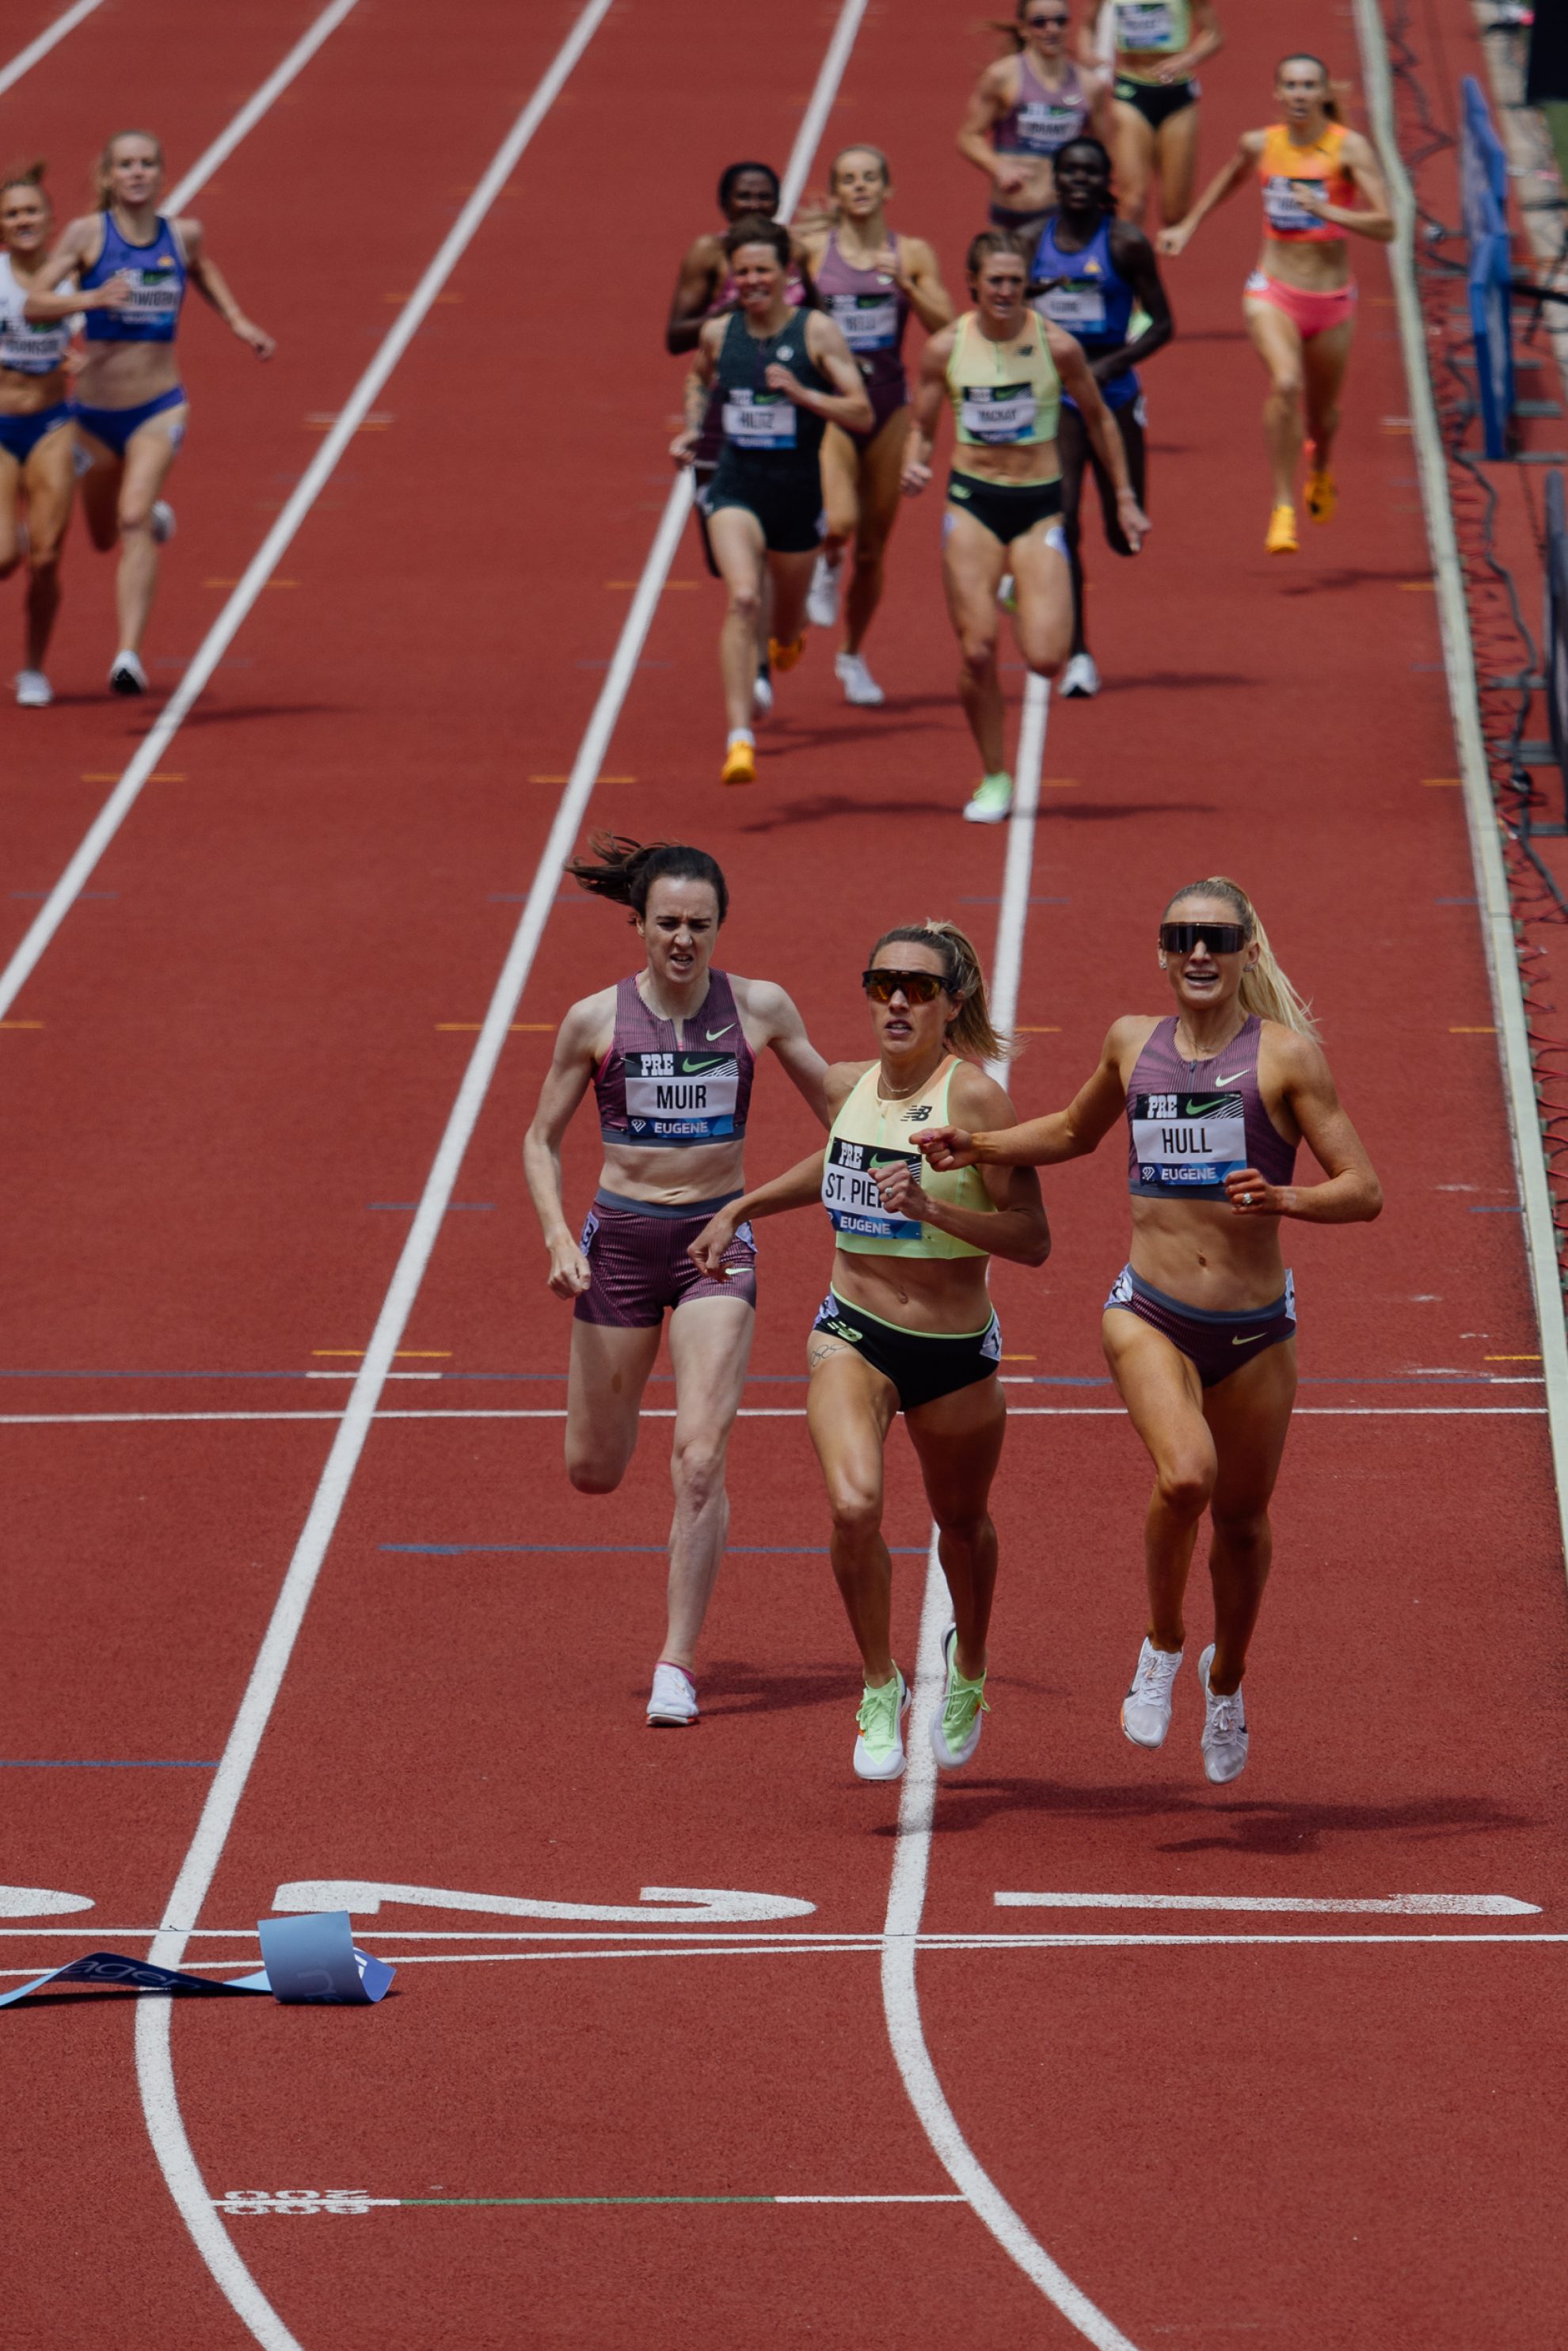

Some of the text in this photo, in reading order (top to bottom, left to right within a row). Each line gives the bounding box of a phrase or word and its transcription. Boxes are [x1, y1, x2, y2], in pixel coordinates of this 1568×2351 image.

[641, 1053, 673, 1076] PRE
[657, 1085, 706, 1109] MUIR
[1147, 1094, 1178, 1119] PRE
[654, 1121, 709, 1134] EUGENE
[1162, 1128, 1212, 1154] HULL
[838, 1142, 864, 1170] PRE
[1161, 1167, 1216, 1181] EUGENE
[825, 1173, 846, 1202] ST.
[840, 1215, 891, 1235] EUGENE
